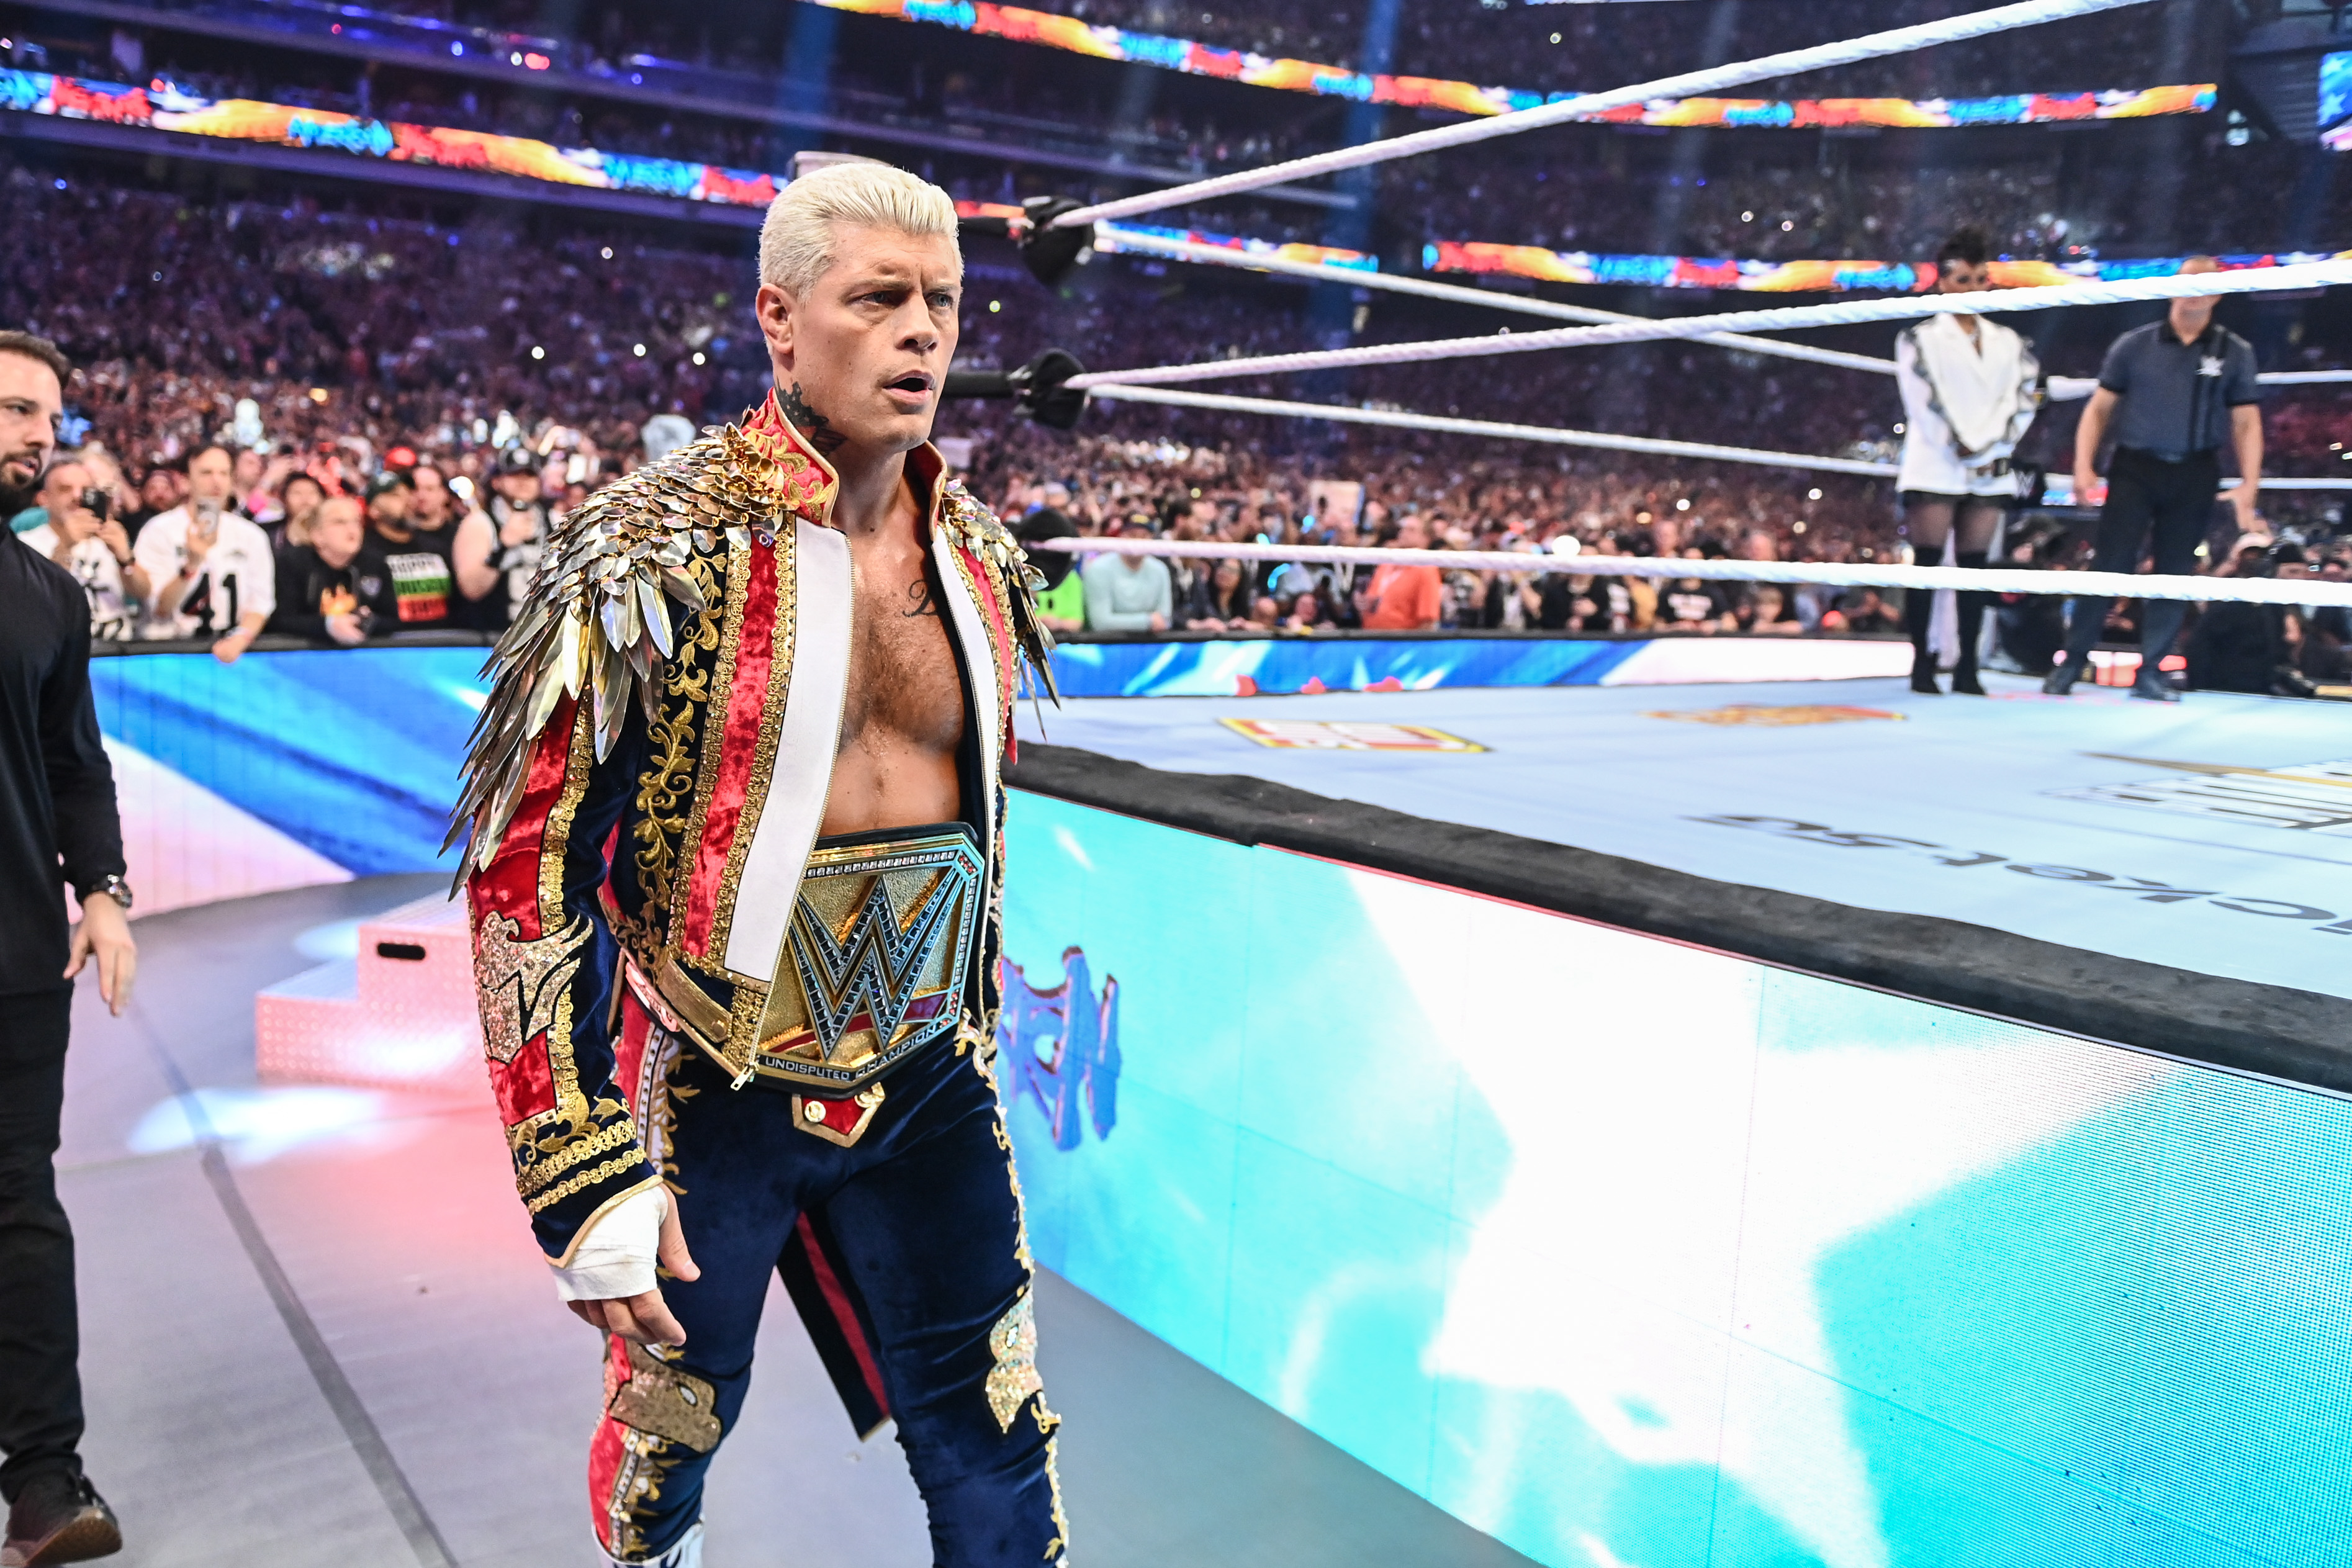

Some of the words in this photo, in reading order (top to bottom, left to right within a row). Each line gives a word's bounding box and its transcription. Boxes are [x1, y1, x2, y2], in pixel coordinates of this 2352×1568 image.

[181, 574, 239, 638] 41
[765, 1056, 850, 1081] UNDISPUTED
[854, 1024, 938, 1080] CHAMPION
